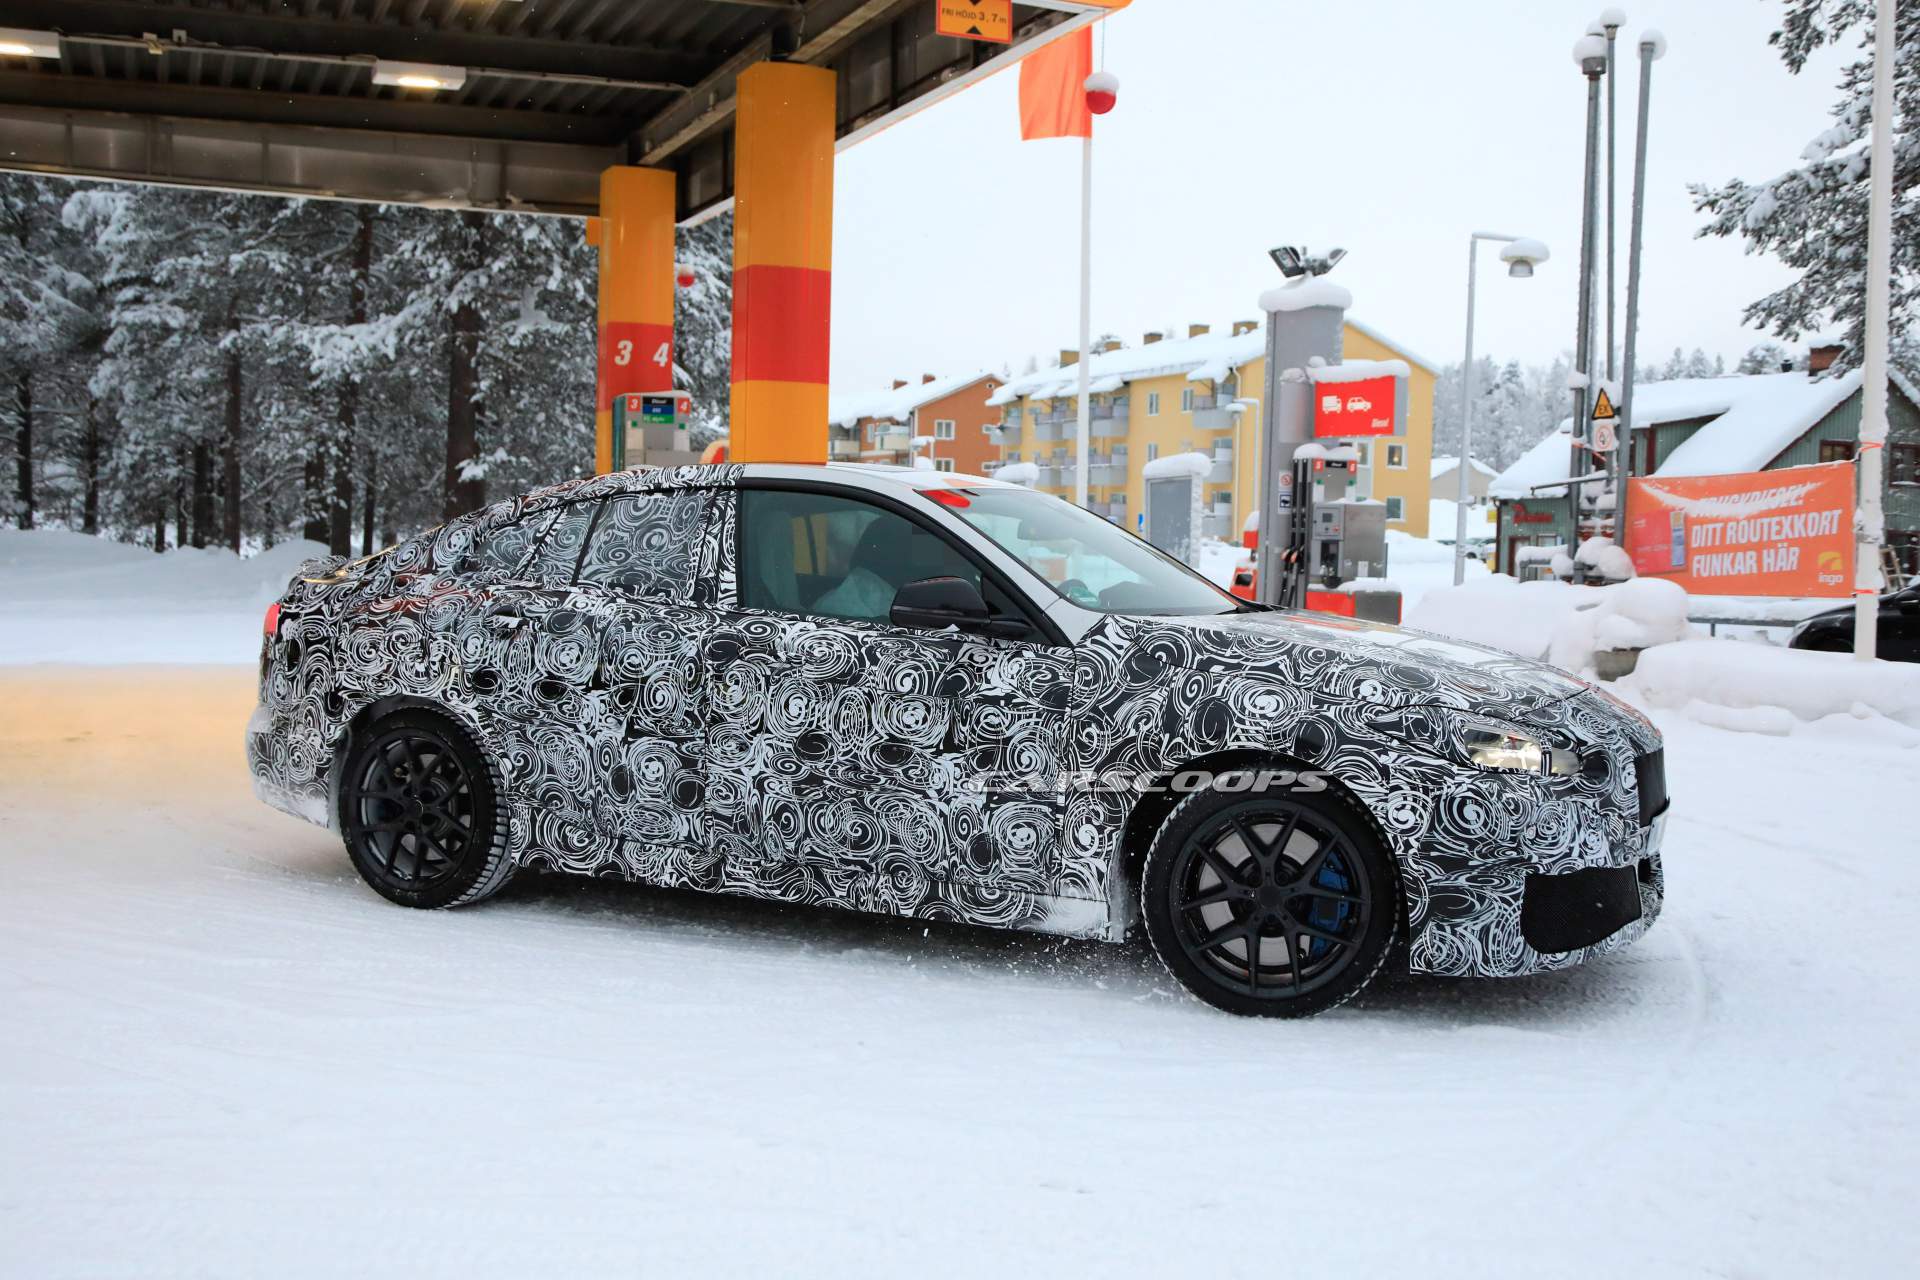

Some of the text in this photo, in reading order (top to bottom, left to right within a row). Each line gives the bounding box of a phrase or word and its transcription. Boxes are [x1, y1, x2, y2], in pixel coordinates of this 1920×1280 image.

[942, 8, 954, 17] FRI
[614, 339, 670, 368] 3 4
[631, 398, 639, 409] 3
[680, 401, 688, 411] 4
[1691, 522, 1725, 549] DITT
[1692, 542, 1800, 578] FUNKAR HÄR
[1818, 572, 1844, 586] ingo
